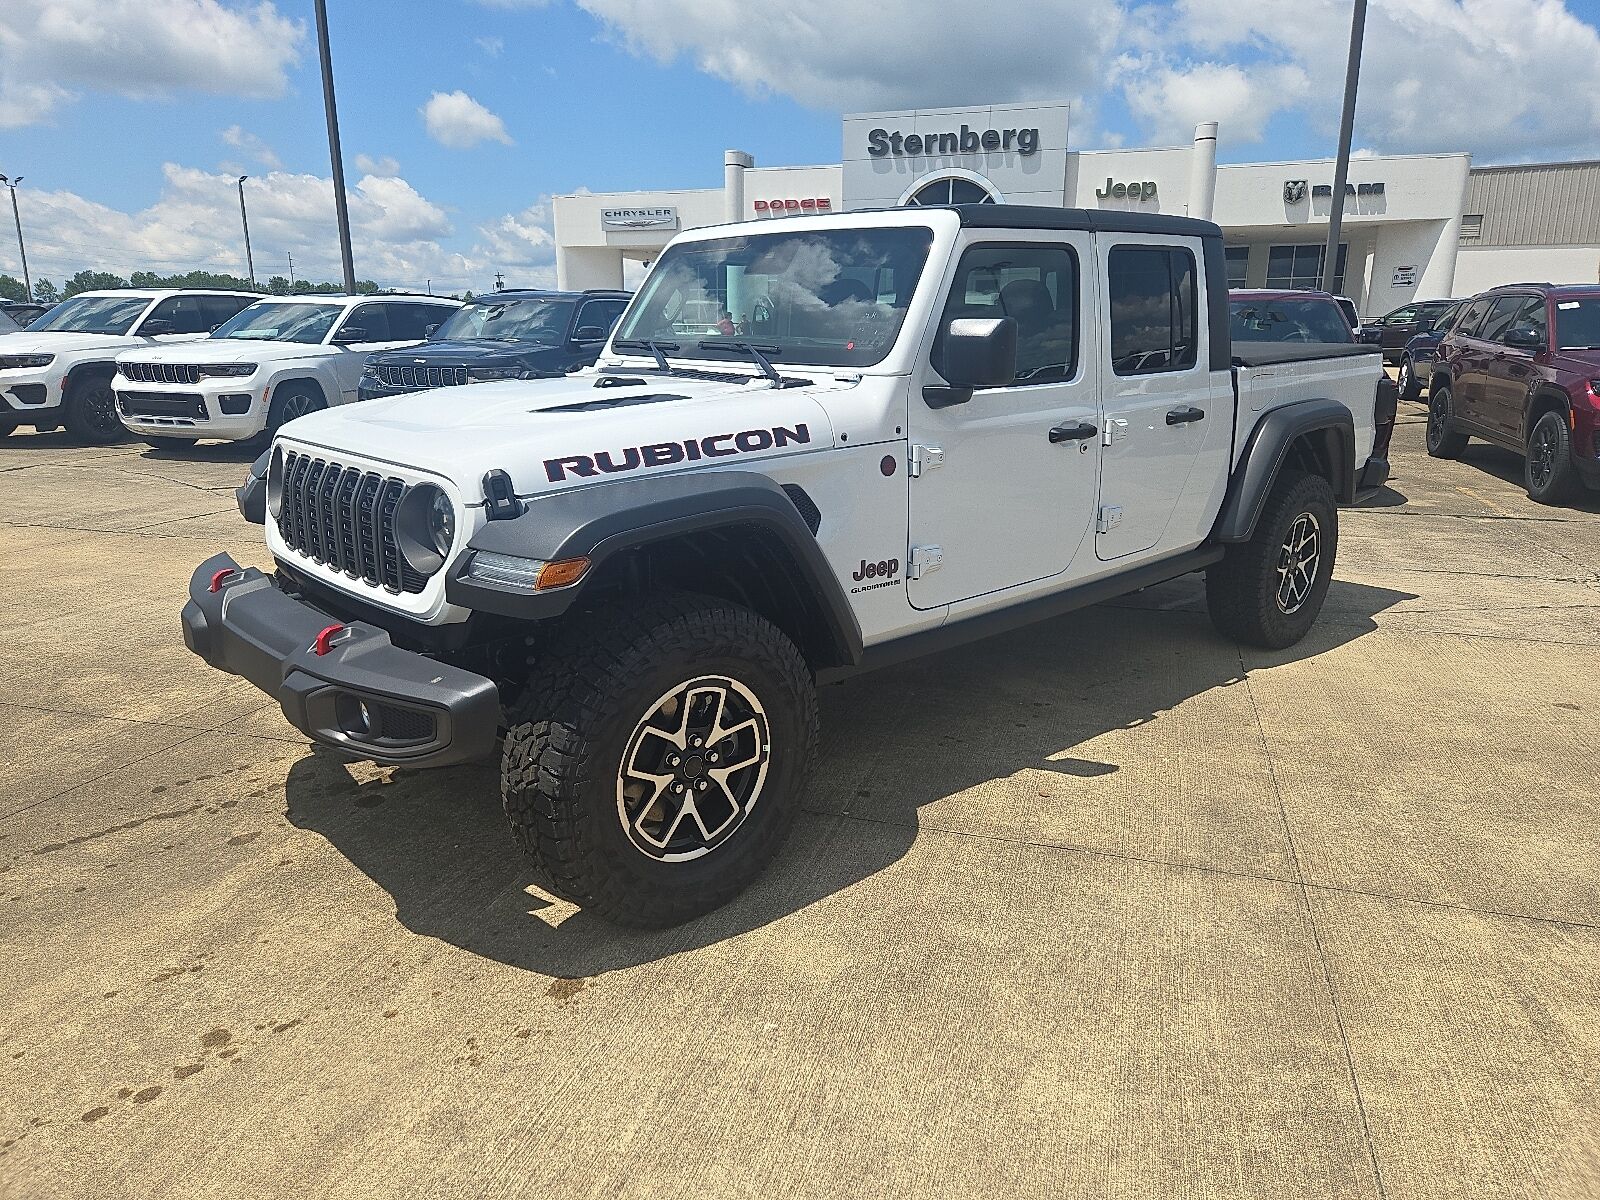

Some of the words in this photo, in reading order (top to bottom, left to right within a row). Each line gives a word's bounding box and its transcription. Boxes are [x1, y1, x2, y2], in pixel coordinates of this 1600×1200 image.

[867, 125, 1039, 156] Sternberg
[1095, 178, 1157, 201] Jeep
[604, 209, 671, 217] CHRYSLER
[754, 199, 831, 210] DODGE
[543, 424, 811, 482] RUBICON
[852, 558, 899, 581] Jeep
[850, 580, 894, 593] GLADIATOR
